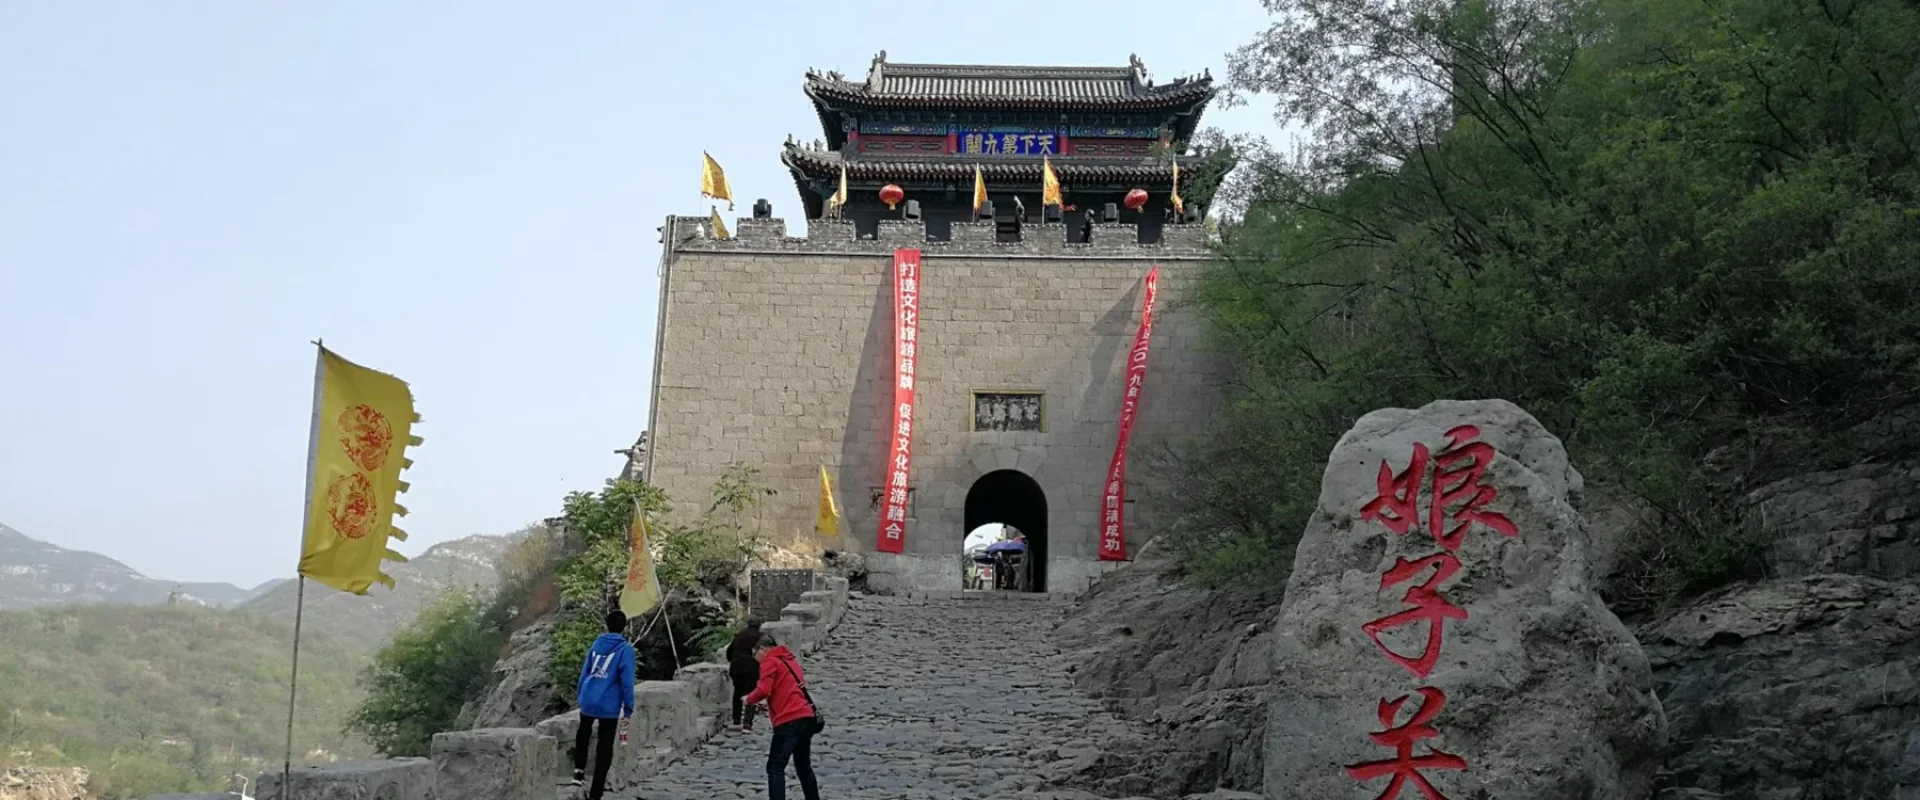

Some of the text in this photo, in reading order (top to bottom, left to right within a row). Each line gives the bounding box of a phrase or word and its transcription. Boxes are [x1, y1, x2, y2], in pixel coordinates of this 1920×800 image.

[885, 262, 916, 540] 打造文化旅游品牌 促进文化旅游融合
[1344, 424, 1519, 800] 娘子关
